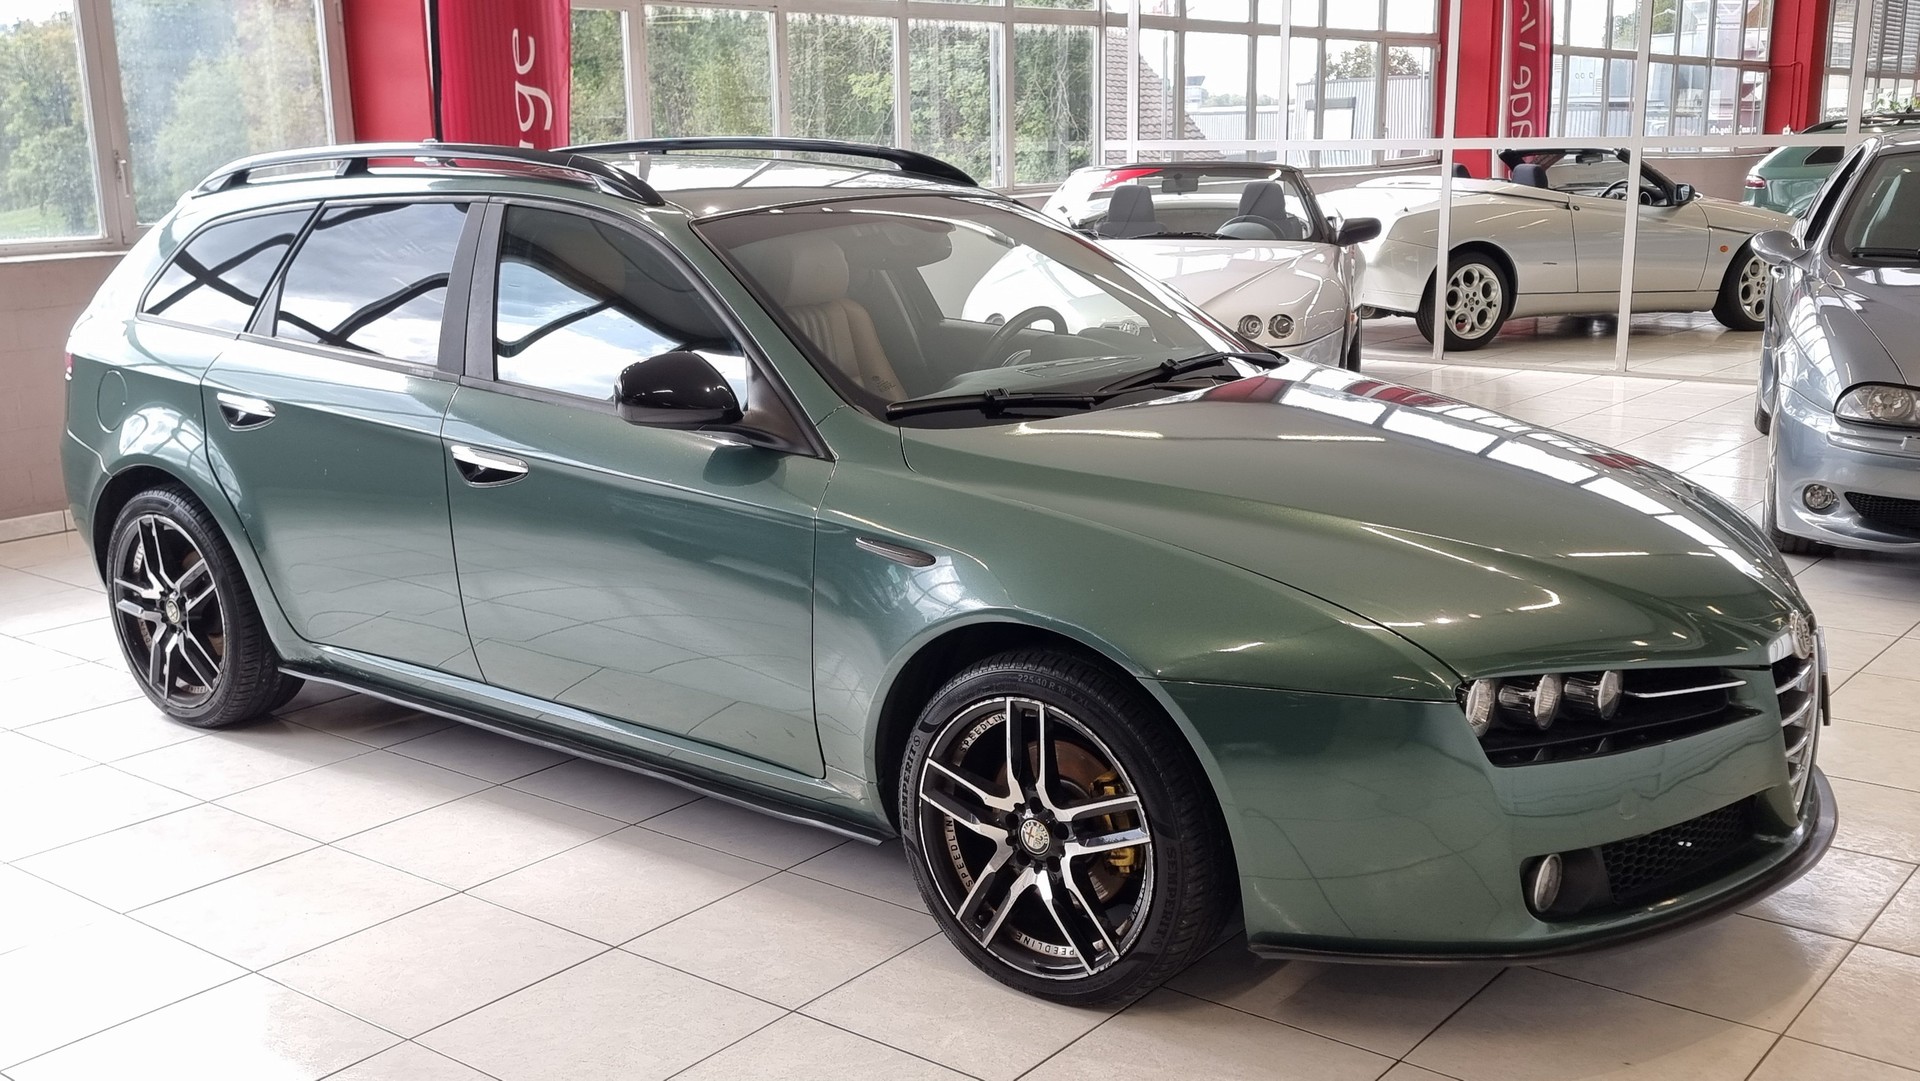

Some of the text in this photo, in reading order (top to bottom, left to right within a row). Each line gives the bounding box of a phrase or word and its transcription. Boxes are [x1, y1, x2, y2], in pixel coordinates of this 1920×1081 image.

[960, 712, 1006, 752] SPEEDLIN
[901, 744, 917, 831] SEMPERIT
[1156, 847, 1178, 935] SEMPERIT
[1015, 930, 1078, 956] PEEDLINE
